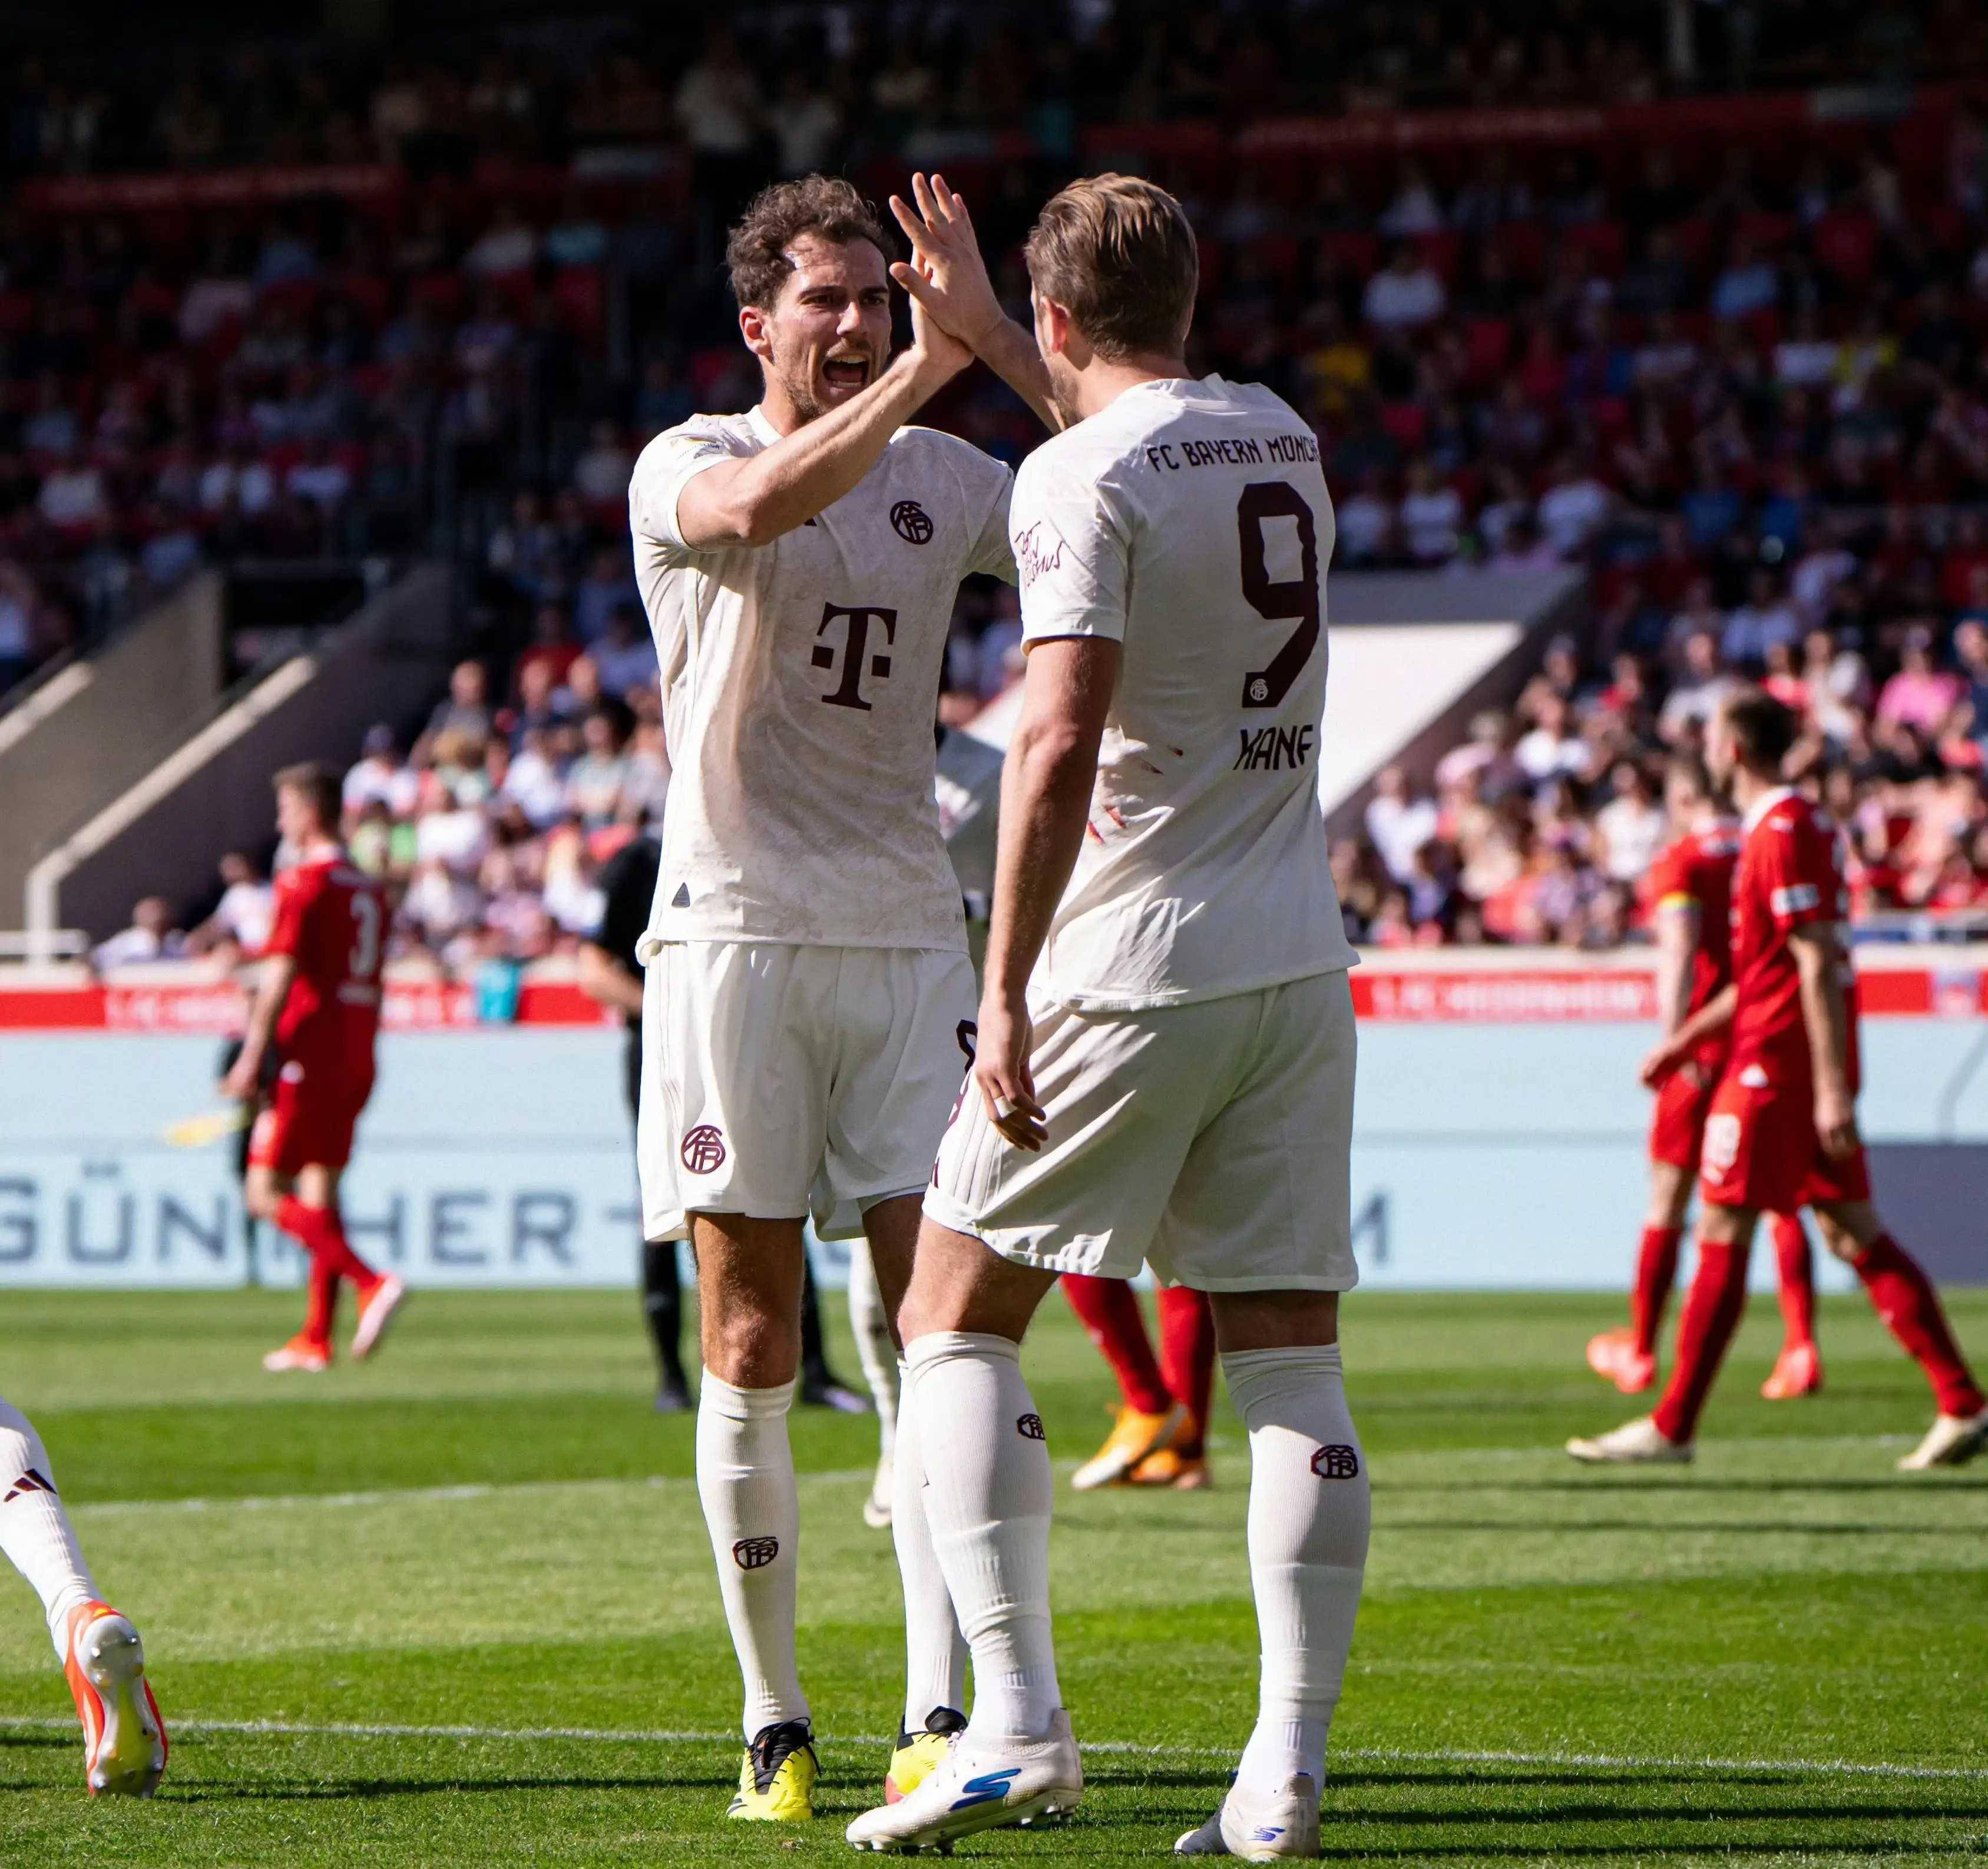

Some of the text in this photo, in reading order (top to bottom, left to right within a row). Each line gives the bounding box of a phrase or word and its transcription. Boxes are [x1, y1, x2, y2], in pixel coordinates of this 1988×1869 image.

[1146, 444, 1179, 472] FC
[1180, 438, 1263, 467] BAYERN
[1237, 481, 1319, 708] 9
